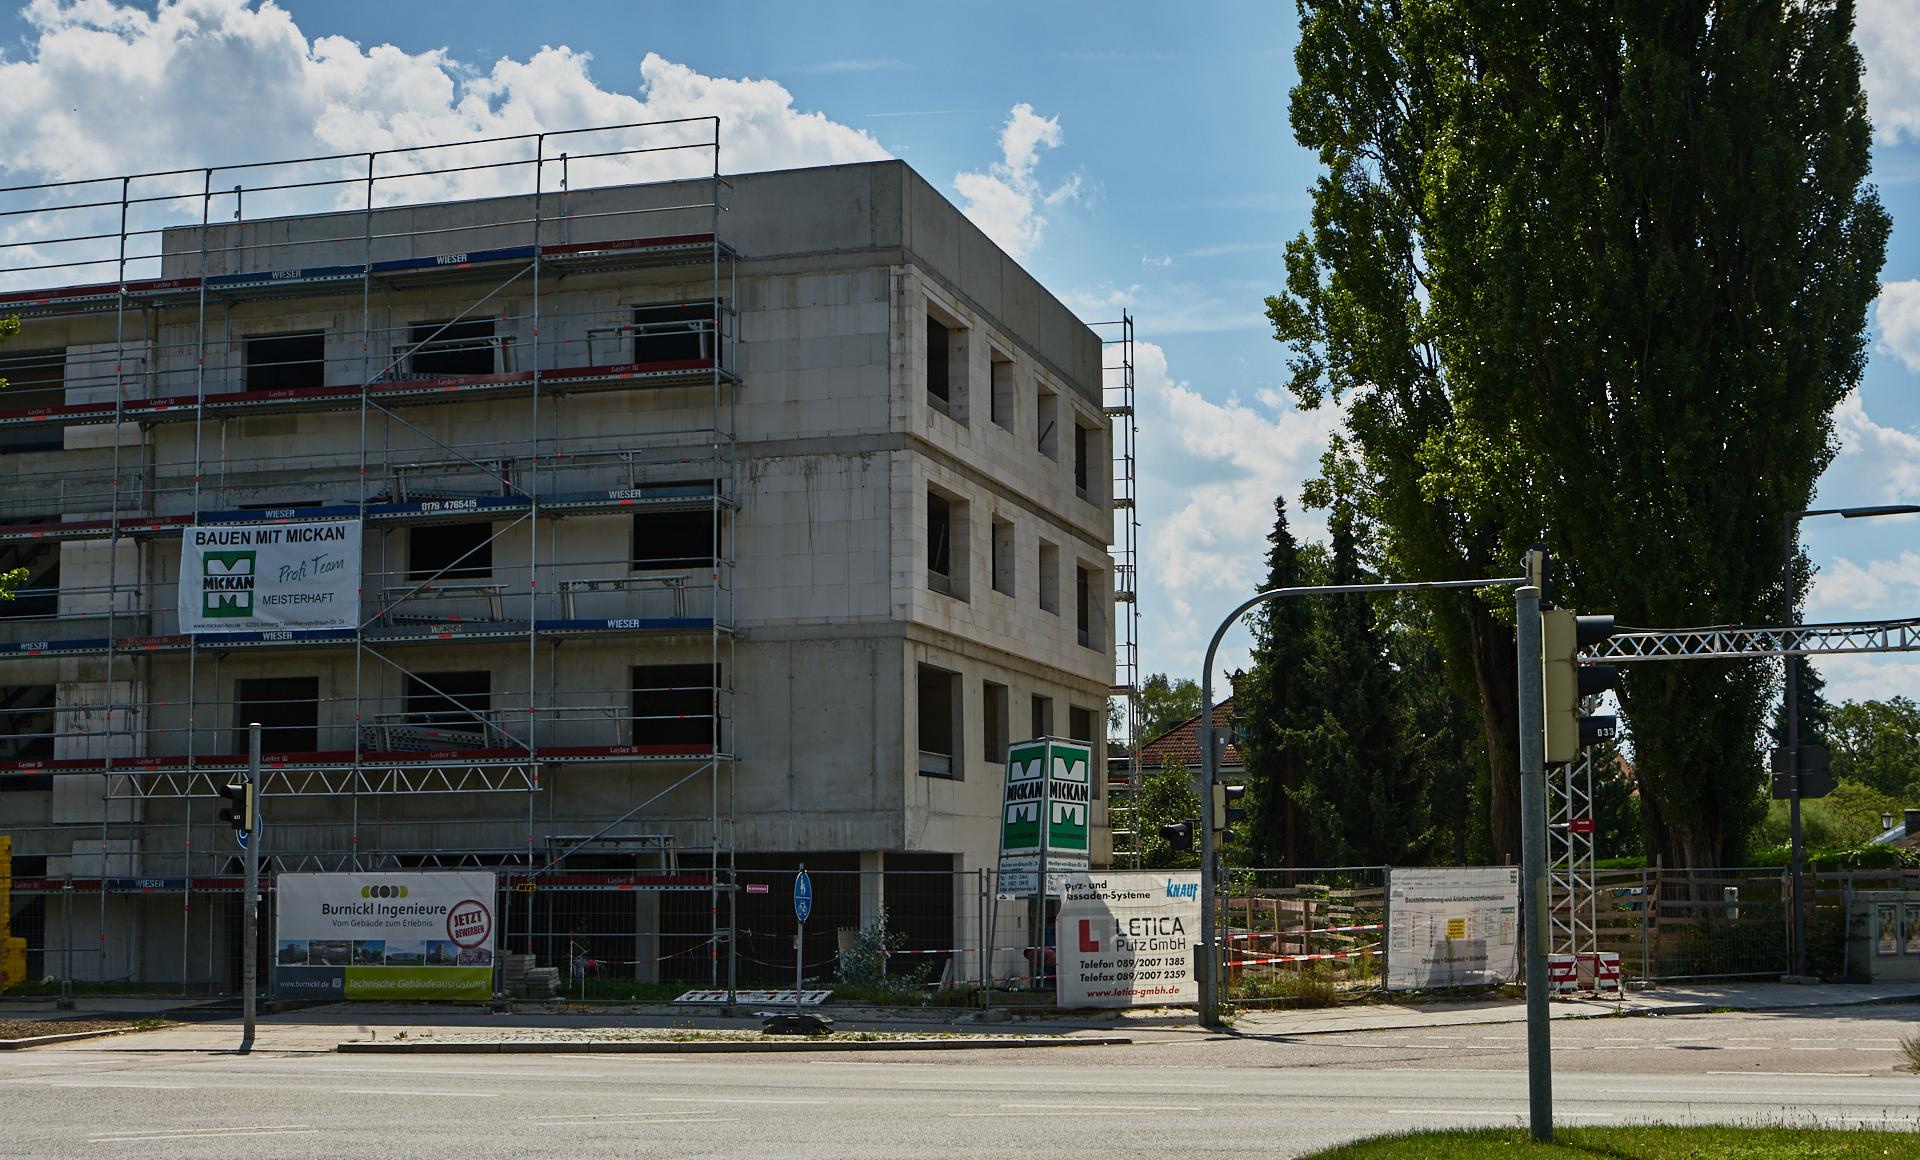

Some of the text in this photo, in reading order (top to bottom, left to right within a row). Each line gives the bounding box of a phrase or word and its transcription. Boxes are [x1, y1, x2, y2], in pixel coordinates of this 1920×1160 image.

[436, 252, 467, 264] WIESER
[271, 269, 301, 279] WIESER
[608, 489, 641, 500] WIESER
[265, 508, 295, 519] WIESER
[195, 526, 345, 545] BAUEN MIT MICKAN
[279, 553, 344, 583] Profi Team
[203, 576, 254, 590] MICKAN
[262, 592, 334, 605] MEISTERHAFT
[607, 618, 640, 629] WIESER
[262, 631, 293, 641] WIESER
[20, 641, 49, 651] WIESER
[1597, 727, 1614, 737] 033
[1006, 781, 1043, 802] MICKAN
[1050, 781, 1088, 802] MICKAN
[135, 879, 164, 888] WIESER
[1089, 880, 1107, 889] und
[322, 903, 447, 918] Burnickl Ingenieure
[332, 919, 348, 927] Vom
[350, 919, 383, 927] Gebäude
[402, 919, 435, 927] Erlebnis.
[453, 910, 482, 928] JETZT
[454, 925, 485, 938] BEWERBEN
[1116, 917, 1185, 937] LETICA
[1116, 938, 1186, 952] Putz GmbH
[1080, 958, 1185, 969] Telefon 089/2007 1385
[1080, 970, 1186, 982] Telefax 089/2007 2359
[279, 979, 330, 988] www.burnickl.de
[348, 978, 486, 990] Technische Gebäudeausrüstung
[1086, 985, 1180, 998] www.letica-gmbh.de
